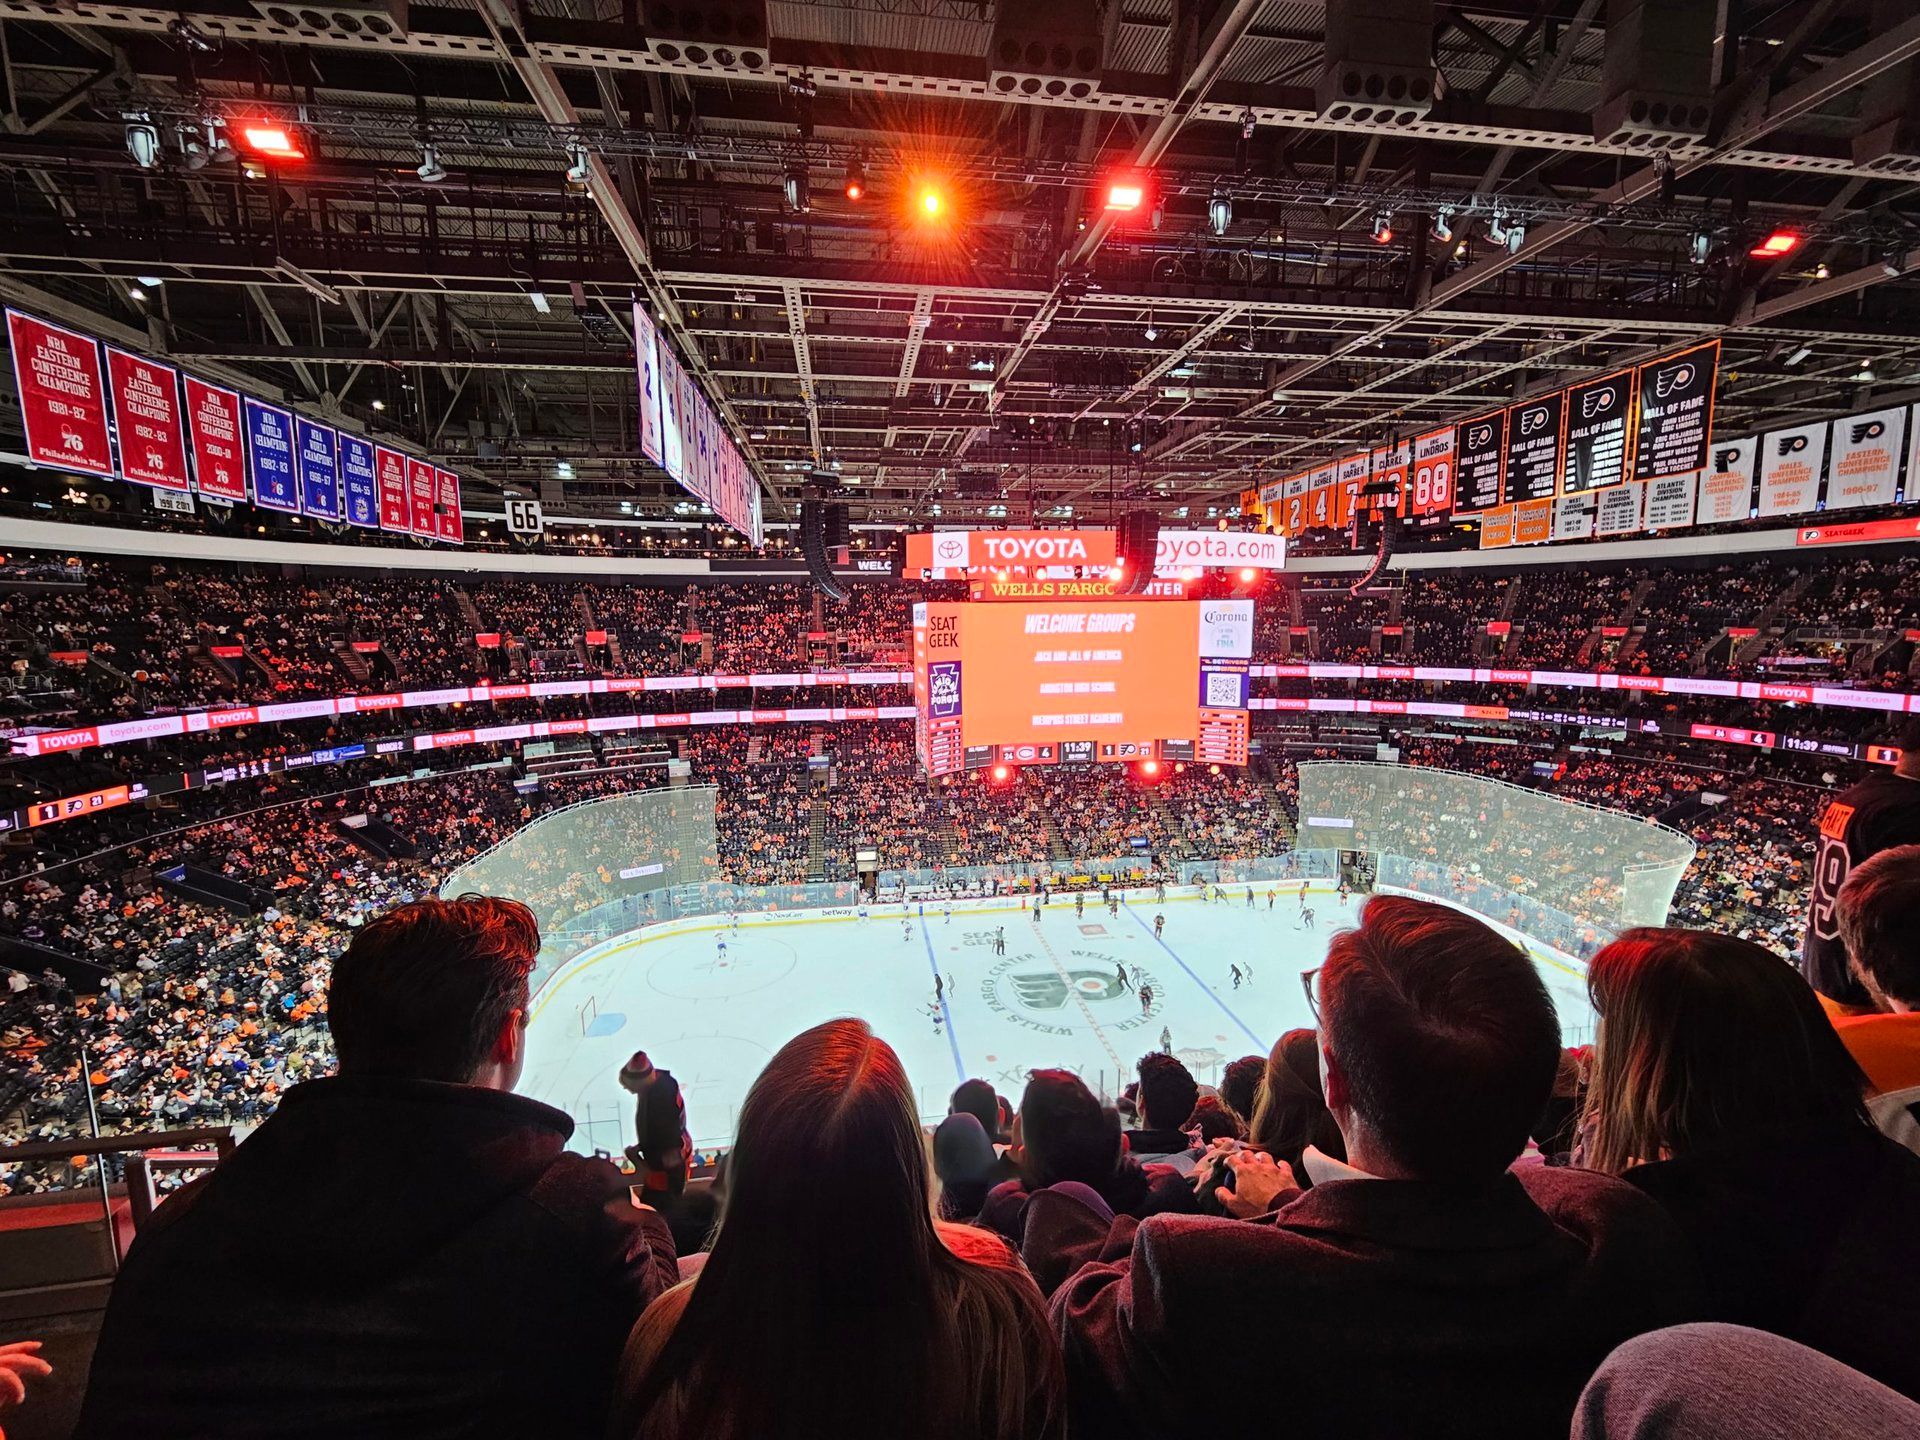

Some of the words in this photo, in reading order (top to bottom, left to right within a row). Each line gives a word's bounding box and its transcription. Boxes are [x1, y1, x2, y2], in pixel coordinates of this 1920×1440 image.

[46, 335, 68, 353] NBA
[36, 345, 82, 370] EASTERN
[31, 358, 91, 387] CONFERENCE
[135, 367, 153, 383] NBA
[37, 373, 91, 399] CHAMPIONS
[128, 376, 163, 398] EASTERN
[644, 360, 652, 400] 2
[123, 387, 170, 412] CONFERENCE
[206, 392, 221, 407] NBA
[48, 400, 87, 421] 1981-82
[127, 401, 171, 423] CHAMPIONS
[201, 400, 229, 419] EASTERN
[1643, 406, 1665, 420] HALL
[1667, 403, 1679, 414] OF
[1680, 395, 1705, 410] FAME
[197, 411, 234, 432] CONFERENCE
[262, 412, 277, 426] NBA
[135, 424, 168, 443] 1982-83
[200, 423, 234, 441] CHAMPIONS
[260, 423, 283, 439] WORLD
[311, 429, 323, 442] NBA
[1571, 427, 1589, 439] HALL
[1590, 424, 1600, 434] OF
[1601, 418, 1622, 431] FAME
[1661, 424, 1674, 433] ERIC
[61, 432, 84, 451] 76
[308, 439, 328, 454] WORLD
[1511, 441, 1526, 453] HALL
[1527, 440, 1536, 449] OF
[1536, 435, 1555, 446] FAME
[351, 443, 362, 455] NBA
[1419, 441, 1449, 459] LINDROS
[1675, 445, 1699, 456] WATSON
[1845, 448, 1885, 460] EASTERN
[39, 447, 89, 465] Philadelphia
[88, 457, 107, 470] 76ers
[146, 452, 163, 470] 76
[303, 449, 333, 467] CHAMPIONS
[349, 453, 366, 467] WORLD
[1378, 455, 1403, 470] CLARKE
[1460, 454, 1473, 466] HALL
[1474, 454, 1481, 463] OF
[1481, 450, 1497, 461] FAME
[1837, 455, 1891, 469] CONFERENCE
[260, 457, 288, 474] 1982-83
[346, 463, 372, 478] CHAMPIONS
[1778, 461, 1803, 470] WALES
[1838, 463, 1889, 477] CHAMPIONS
[130, 467, 168, 482] Philadelphia
[215, 469, 229, 484] 76
[1709, 470, 1742, 481] CAMPBELL
[1767, 467, 1814, 479] CONFERENCE
[1767, 474, 1811, 486] CHAMPIONS
[1415, 462, 1450, 507] 88
[1656, 480, 1686, 490] ATLANTIC
[1705, 478, 1746, 489] CONFERENCE
[1705, 485, 1745, 495] CHAMPIONS
[1842, 484, 1879, 496] 1996-97
[1608, 489, 1630, 497] PATRICK
[1652, 493, 1687, 503] CHAMPIONS
[1656, 487, 1684, 496] DIVISION
[1315, 490, 1327, 523] 4
[1564, 502, 1585, 510] DIVISION
[1602, 500, 1635, 510] CHAMPIONS
[1607, 495, 1631, 504] DIVISION
[512, 502, 539, 530] 66
[1290, 498, 1302, 531] 2
[1824, 527, 1865, 538] SEATGEEK
[983, 537, 1087, 558] TOYOTA
[1156, 536, 1275, 563] oyota.com
[991, 583, 1054, 596] WELLS
[1143, 582, 1183, 595] NTER
[930, 616, 957, 631] SEAT
[1024, 614, 1086, 634] WELCOME
[1086, 613, 1136, 633] GROUPS
[1204, 610, 1247, 625] Corona
[929, 633, 959, 648] GEEK
[1278, 667, 1307, 676] TOYOTA
[1379, 668, 1412, 677] TOYOTA
[1492, 671, 1529, 681] TOYOTA
[608, 680, 642, 689] TOYOTA
[716, 677, 748, 685] TOYOTA
[818, 675, 847, 683] TOYOTA
[1621, 677, 1660, 688] TOYOTA
[491, 686, 527, 696] TOYOTA
[1674, 681, 1728, 692] toyota.com
[1762, 686, 1808, 699] TOYOTA
[358, 696, 400, 708] TOYOTA
[931, 693, 960, 705] FORGE
[1278, 700, 1307, 709] TOYOTA
[1825, 691, 1891, 705] toyota.com
[270, 703, 325, 716] toyota.com
[847, 709, 876, 717] TOYOTA
[1372, 702, 1405, 711] TOYOTA
[210, 710, 256, 725] TOYOTA
[657, 715, 688, 724] TOYOTA
[754, 711, 784, 720] TOYOTA
[110, 720, 171, 738] toyota.com
[551, 723, 585, 732] TOYOTA
[42, 731, 94, 749] TOYOTA
[435, 732, 471, 744] TOYOTA
[1753, 733, 1763, 744] 4
[1787, 737, 1819, 751] 11:39
[1041, 747, 1050, 758] 4
[1064, 742, 1091, 753] 11:39
[1105, 745, 1113, 756] 1
[316, 752, 335, 763] SZA
[1883, 750, 1893, 761] 1
[45, 805, 54, 819] 1
[91, 795, 103, 806] 21
[821, 908, 853, 917] betway
[988, 953, 1036, 976] CENTER
[1072, 949, 1129, 966] WELLS
[981, 979, 1006, 1014] FARGO
[1006, 1015, 1074, 1037] WELLS
